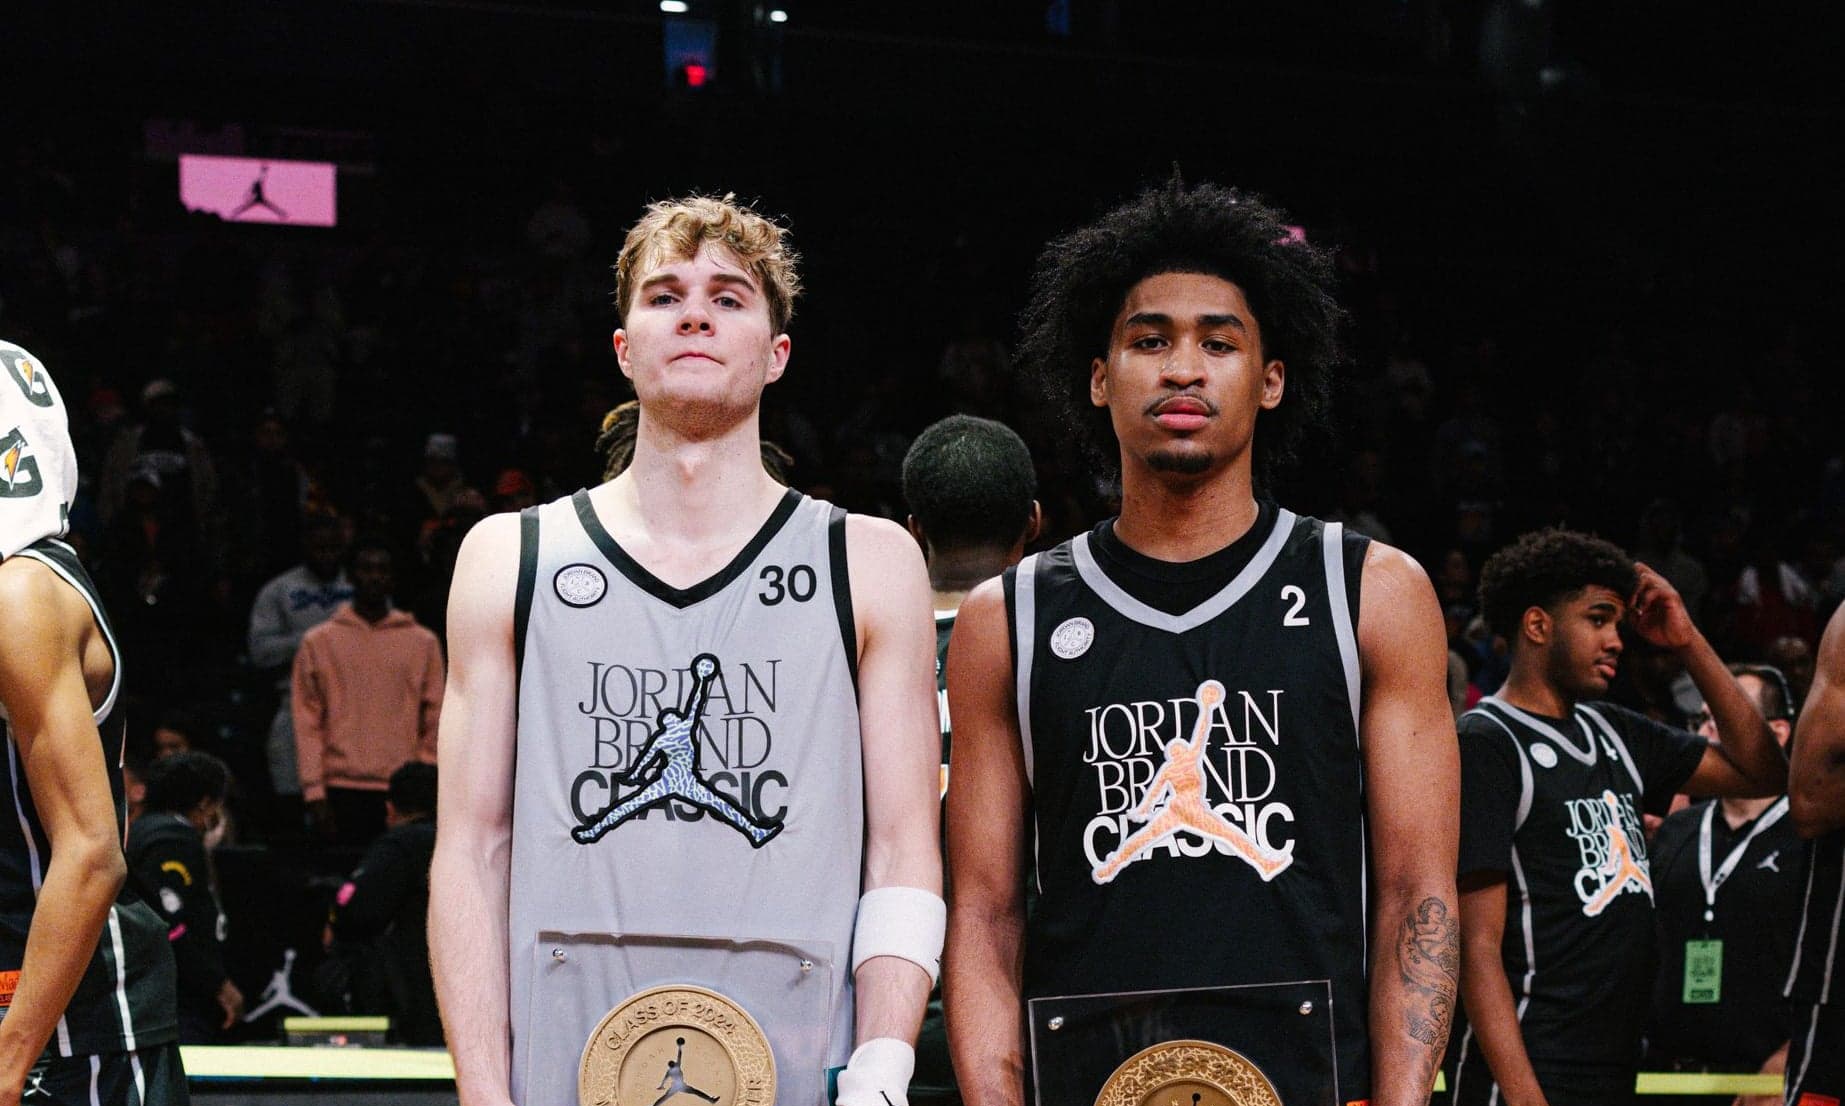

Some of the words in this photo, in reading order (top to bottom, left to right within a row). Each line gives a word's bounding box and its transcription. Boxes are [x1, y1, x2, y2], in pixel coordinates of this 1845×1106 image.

[758, 564, 817, 606] 30
[1280, 585, 1310, 627] 2
[588, 716, 772, 770] BRND
[1091, 746, 1276, 816] BRND
[605, 1005, 658, 1050] CLASS
[662, 1000, 689, 1016] OF
[692, 1003, 737, 1036] 2024
